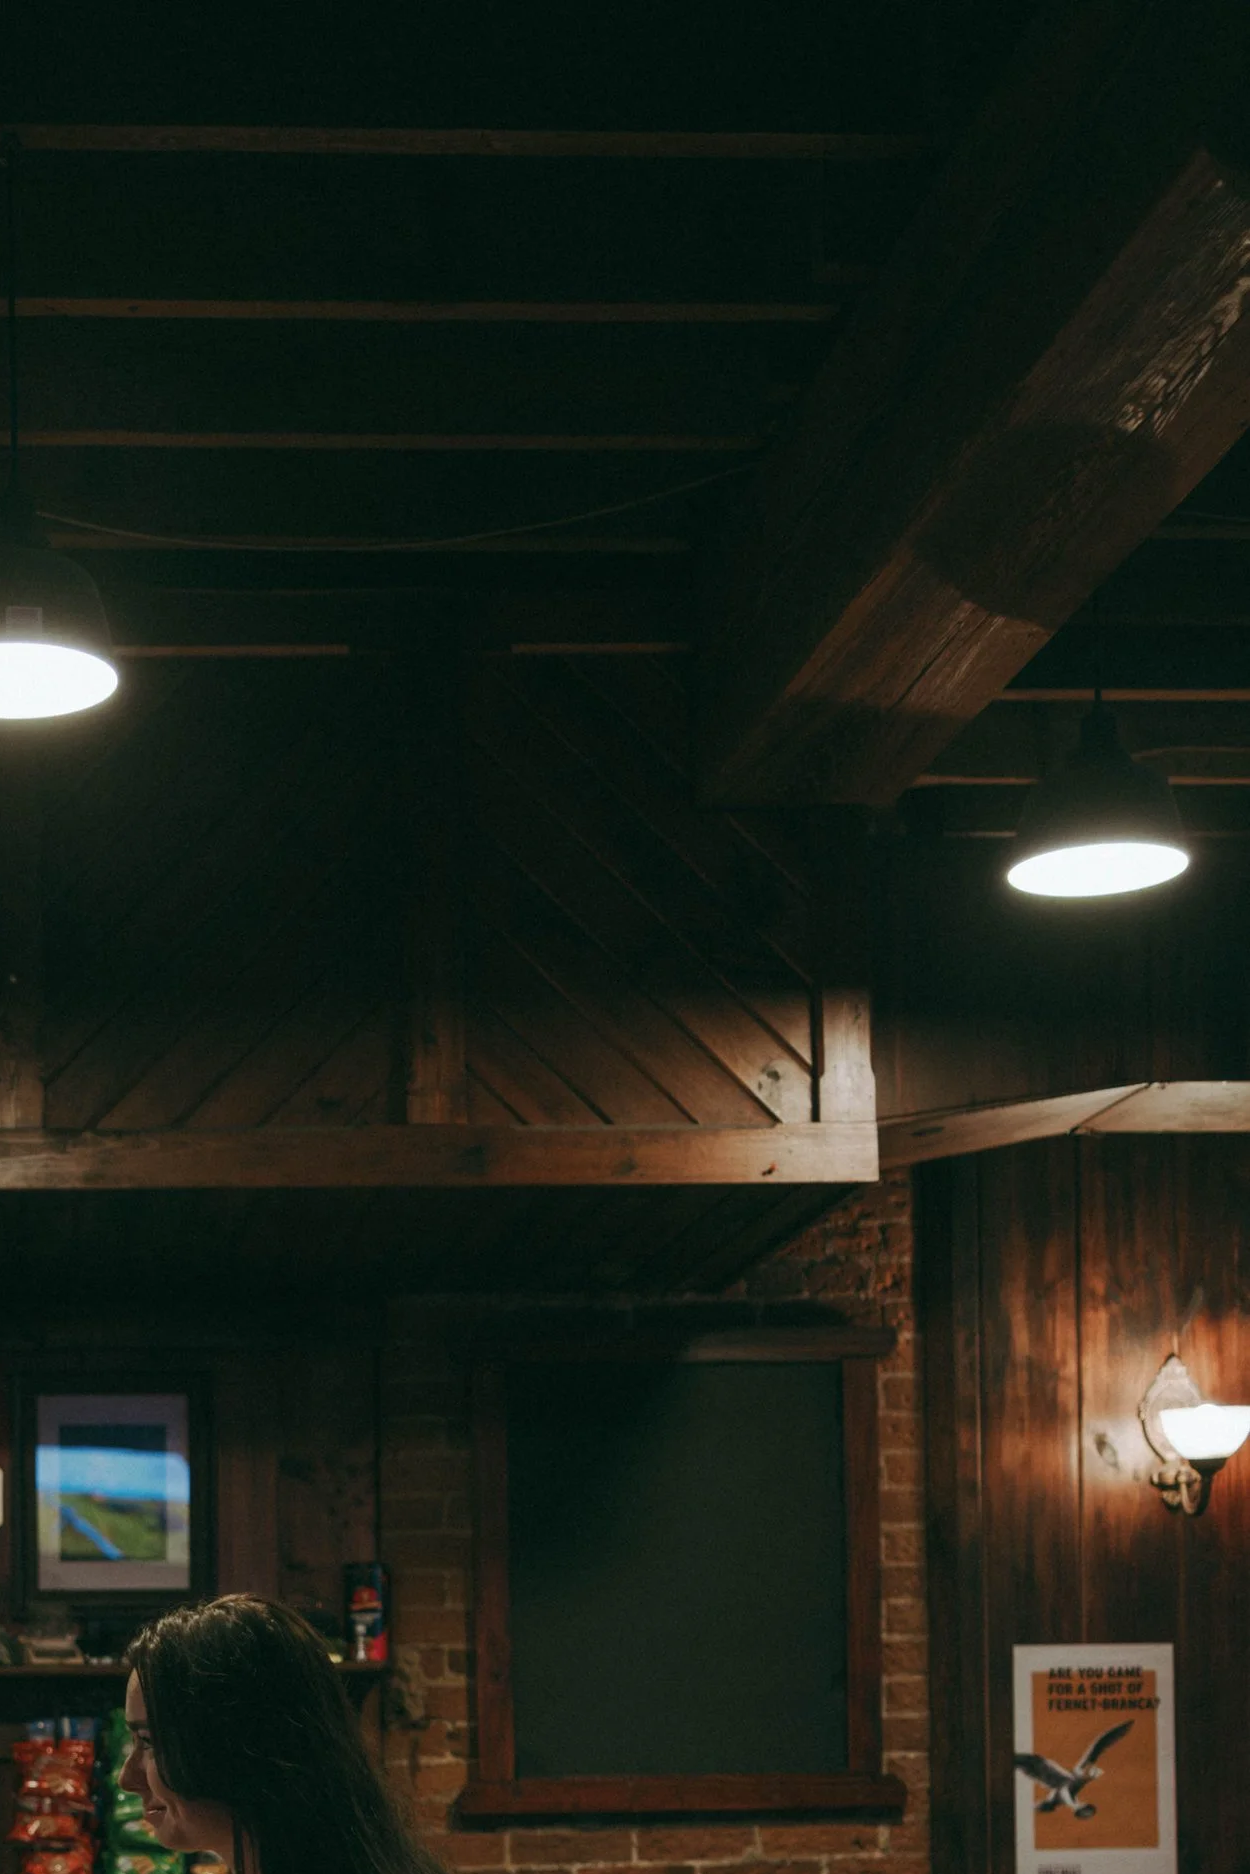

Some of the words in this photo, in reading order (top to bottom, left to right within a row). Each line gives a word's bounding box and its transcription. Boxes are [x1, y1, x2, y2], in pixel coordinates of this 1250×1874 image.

[1048, 1667, 1072, 1679] ARE
[1077, 1667, 1103, 1679] YOU
[1107, 1666, 1143, 1678] GAME
[1047, 1682, 1073, 1695] FOR
[1077, 1683, 1086, 1695] A
[1090, 1682, 1123, 1694] SHOT
[1127, 1682, 1144, 1694] OF
